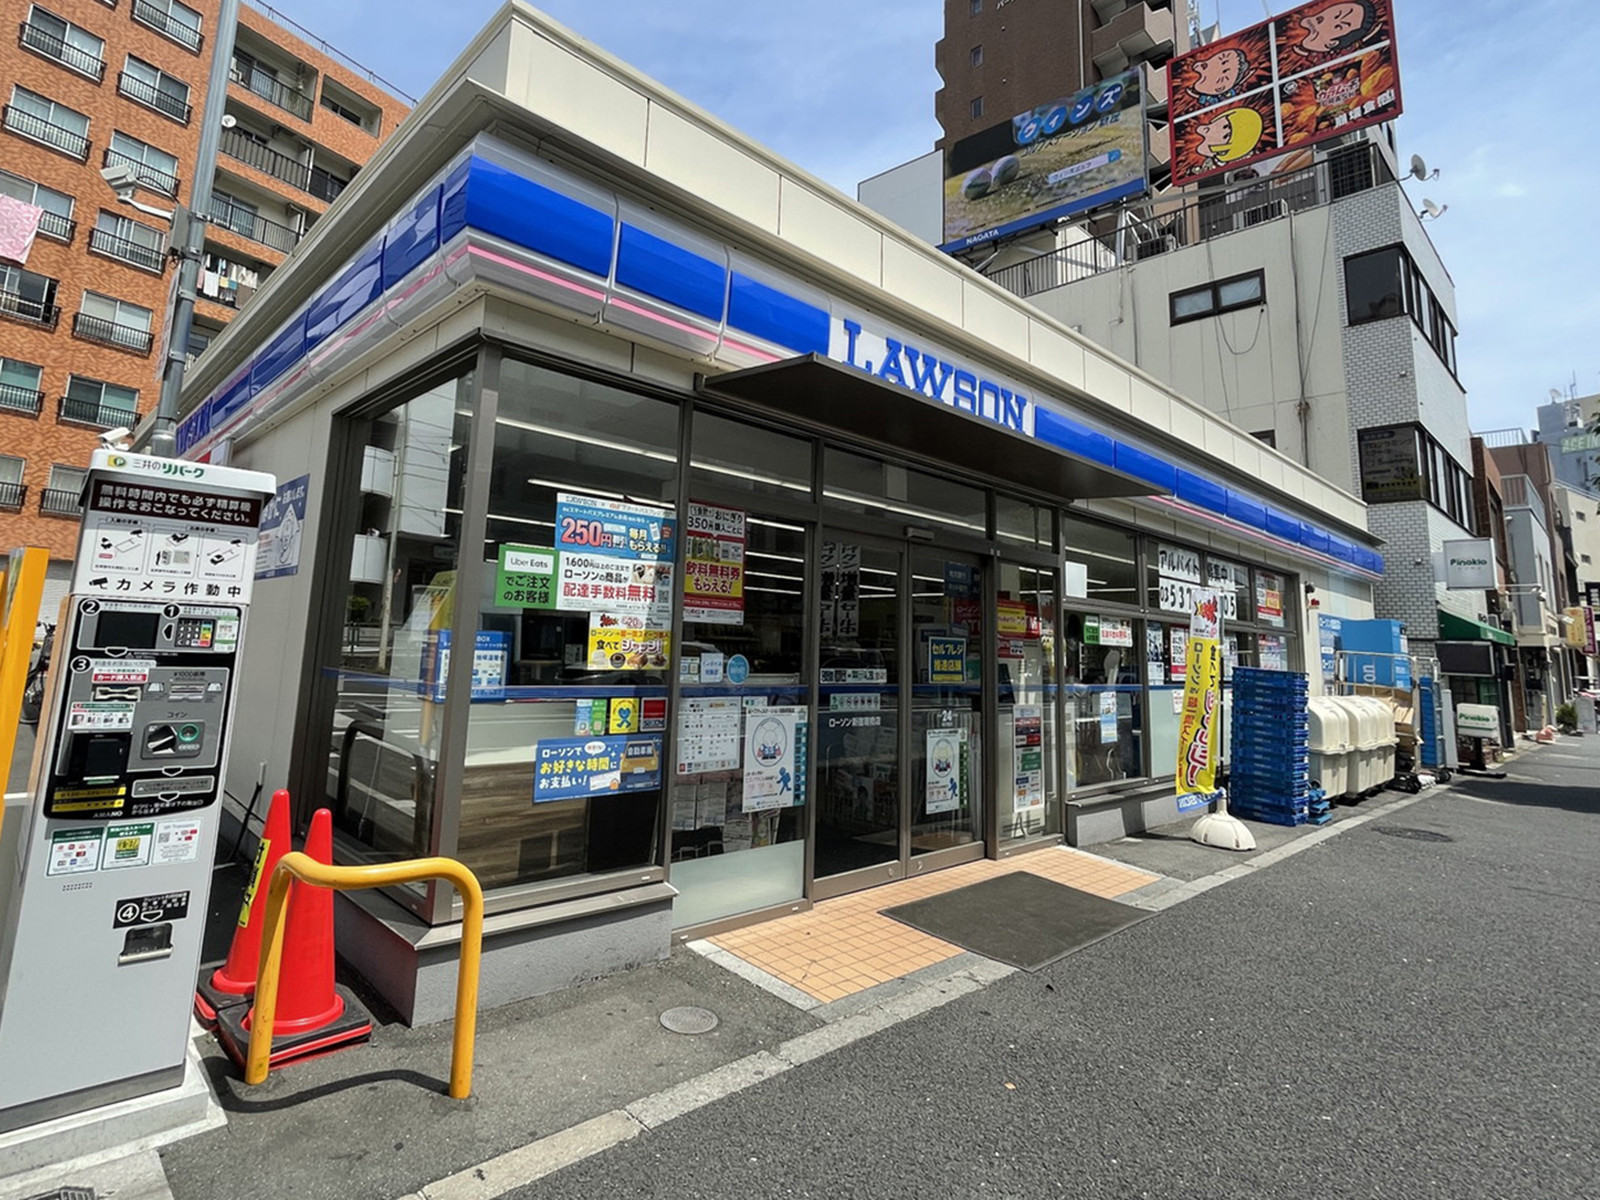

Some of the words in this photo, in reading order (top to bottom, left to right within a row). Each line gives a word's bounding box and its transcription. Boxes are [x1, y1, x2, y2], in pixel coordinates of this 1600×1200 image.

[966, 229, 1000, 245] NAGATA
[842, 319, 1027, 434] LAWSON
[101, 484, 251, 513] 無料時間内でも必ず精算機
[98, 497, 250, 523] 操作をおこなってください。
[629, 527, 648, 541] 毎月
[510, 557, 529, 567] Uber
[530, 559, 549, 569] Eats
[1159, 550, 1200, 577] アルバイト
[1450, 557, 1488, 567] Pinokio
[116, 578, 242, 598] カメラ作動中
[505, 575, 551, 590] でご注文
[693, 575, 733, 594] もらえる!
[503, 589, 550, 605] のお客様
[562, 581, 657, 604] 配達手数料無料
[167, 711, 188, 719] コイン
[1458, 712, 1490, 723] Pinokio
[541, 746, 582, 758] ローソンで
[540, 756, 618, 775] お好きな時間に
[539, 774, 588, 790] お支払い!
